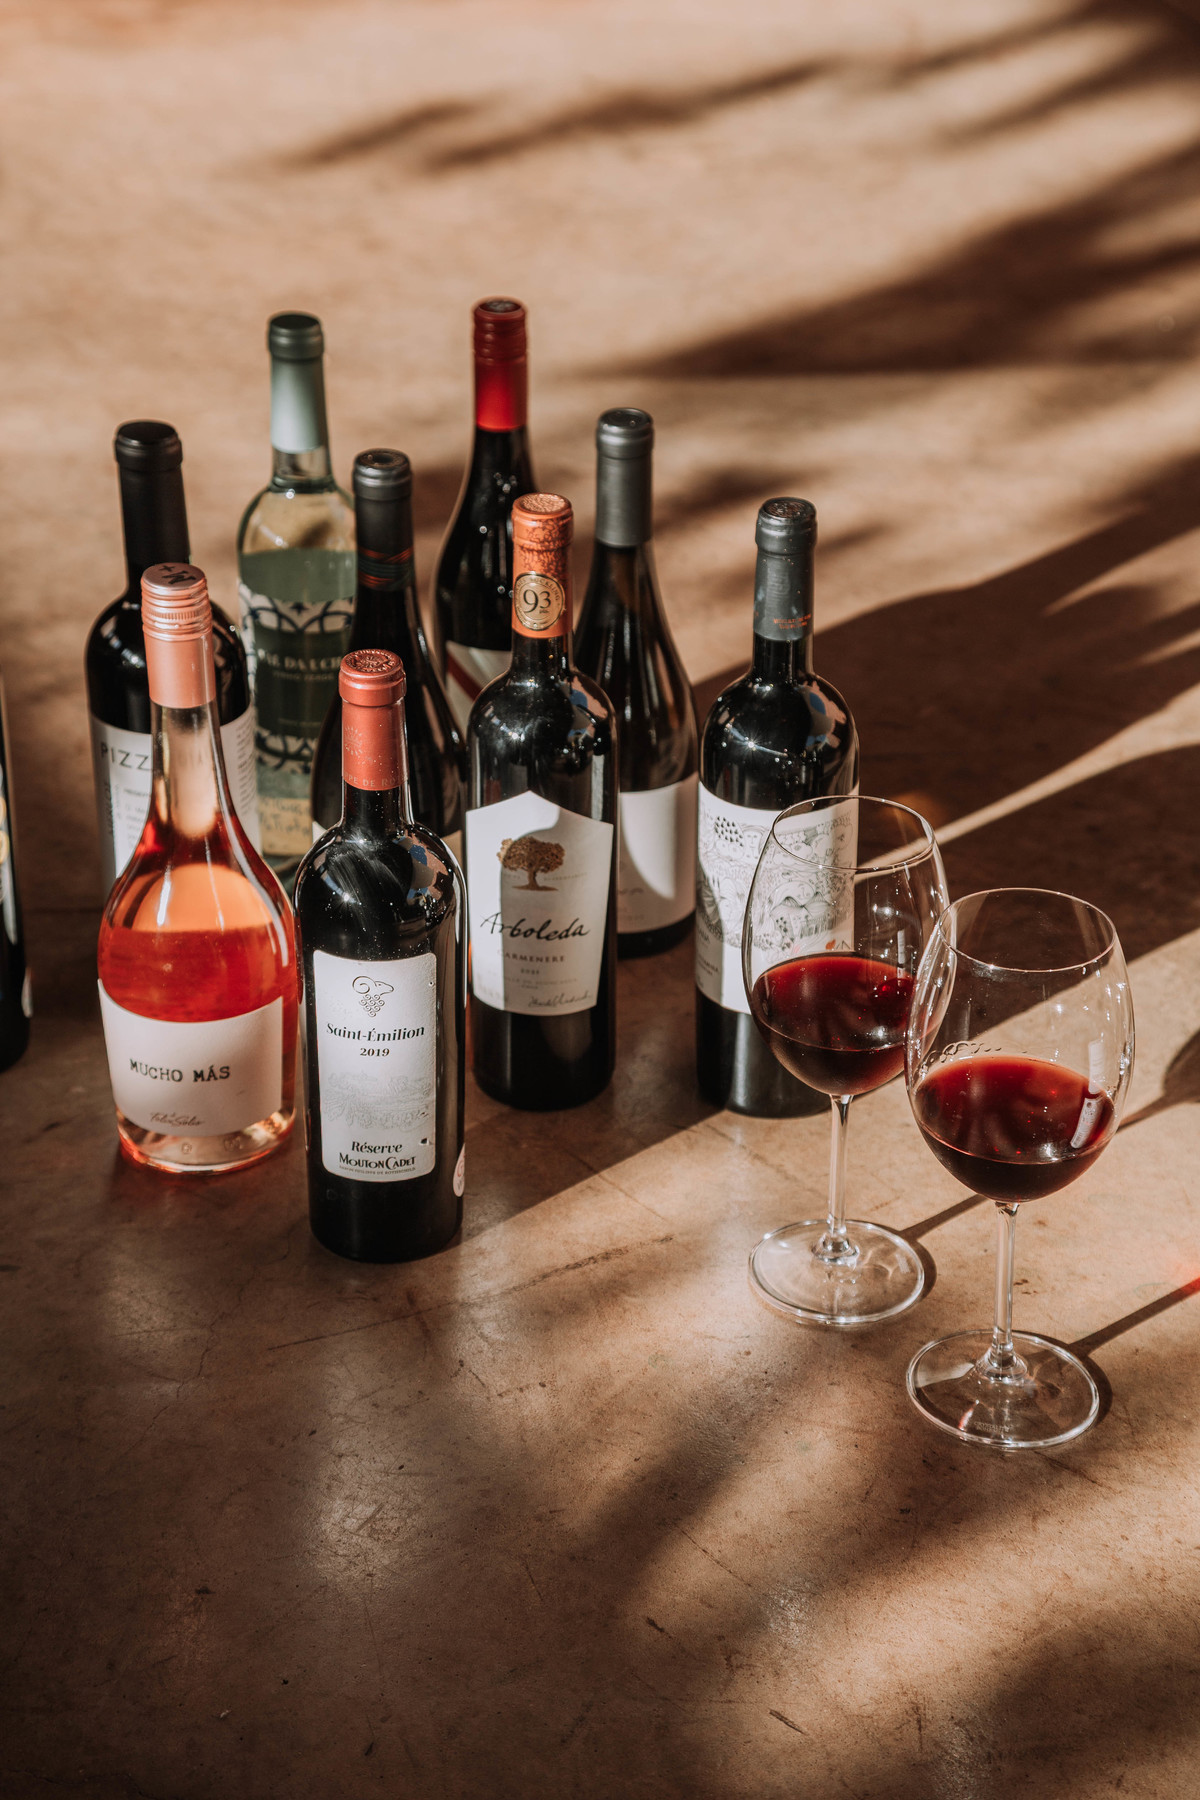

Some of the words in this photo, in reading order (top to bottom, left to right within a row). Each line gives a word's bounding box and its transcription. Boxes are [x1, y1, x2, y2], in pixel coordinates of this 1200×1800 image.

[523, 589, 551, 613] 93
[101, 741, 152, 771] PIZZ
[480, 911, 591, 942] Arboleda
[326, 1022, 425, 1042] Saint-Émilion
[360, 1047, 390, 1057] 2019
[129, 1058, 183, 1083] MUCHO
[192, 1064, 231, 1083] MÁS
[351, 1141, 403, 1154] Réserve
